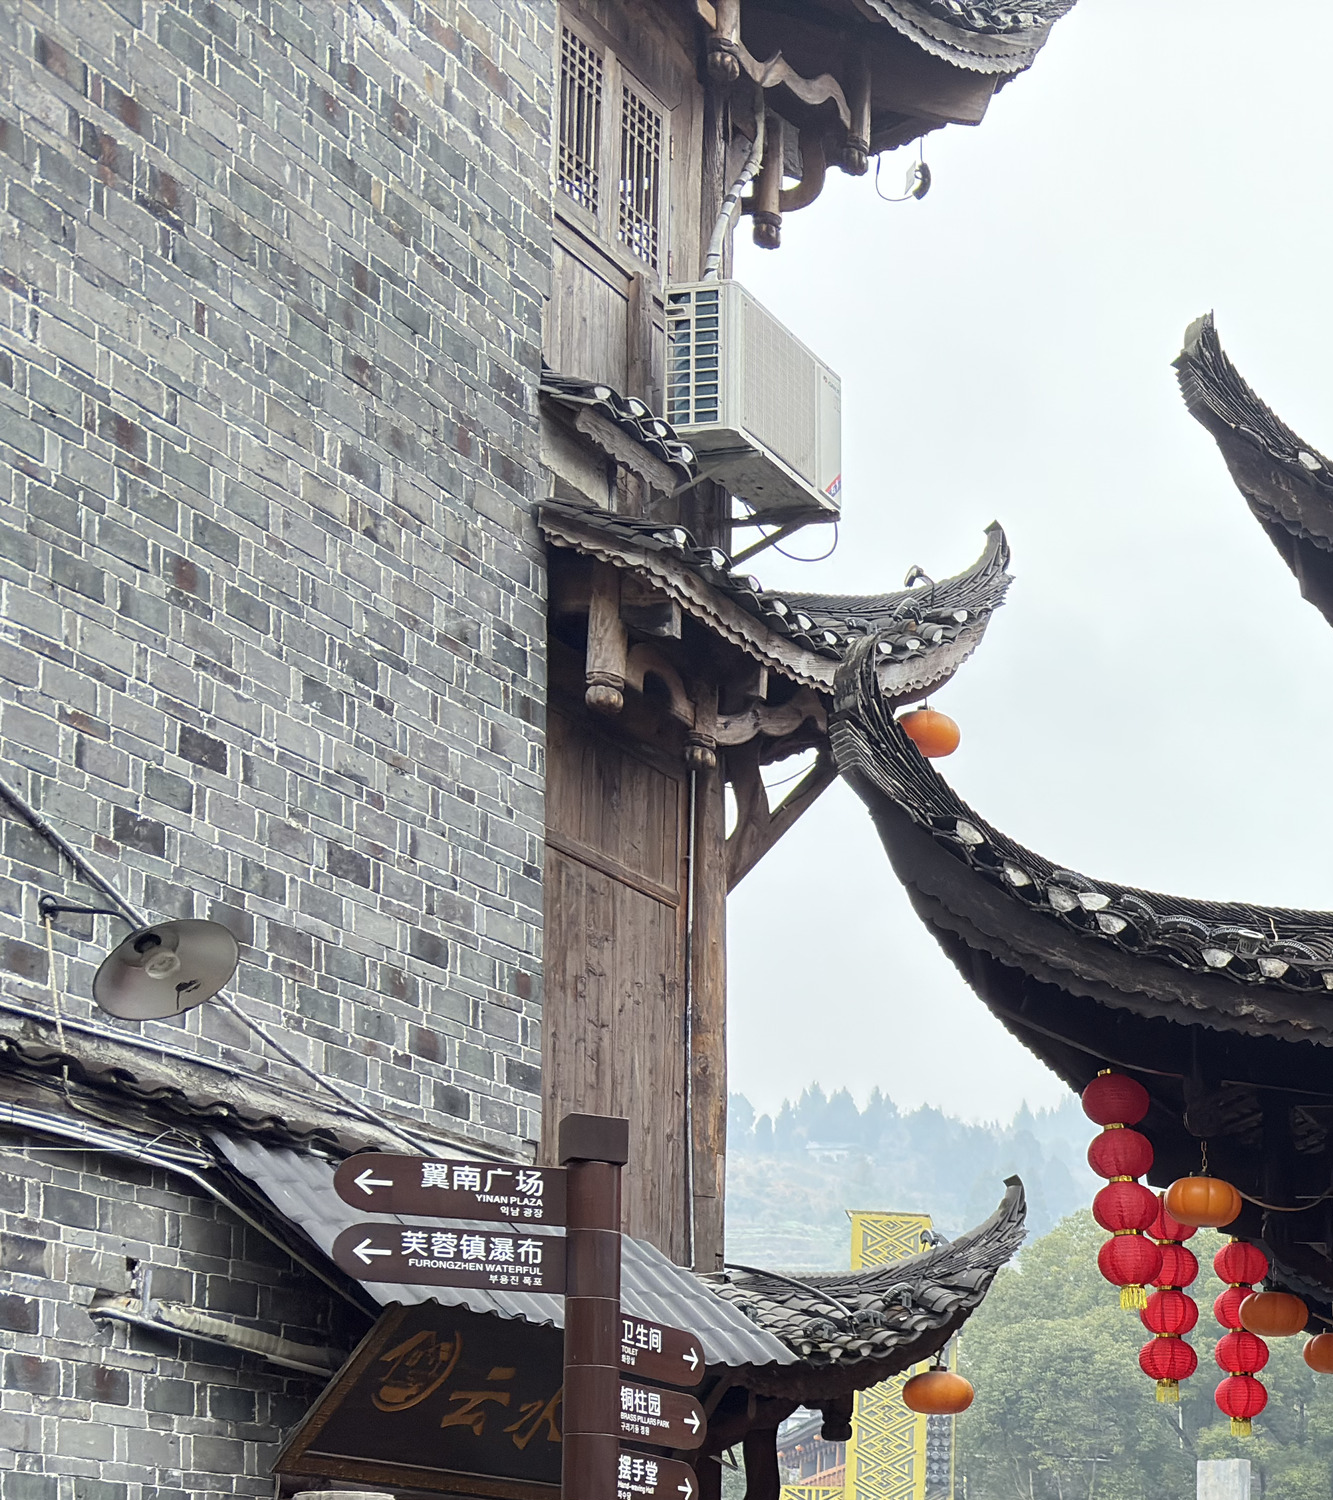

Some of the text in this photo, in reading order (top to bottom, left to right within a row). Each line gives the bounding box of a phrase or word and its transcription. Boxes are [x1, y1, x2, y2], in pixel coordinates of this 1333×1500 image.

[420, 1162, 545, 1197] 翼南广场
[475, 1194, 543, 1207] YINAN PLAZA
[523, 1207, 543, 1218] 광장
[401, 1230, 544, 1264] 芙蓉镇瀑布
[408, 1258, 543, 1275] FURONGZHEN WATERFUL
[488, 1274, 543, 1286] 부용진 폭포
[621, 1319, 662, 1353] 卫生间
[621, 1345, 639, 1356] TOILET
[620, 1386, 661, 1416] 铜柱园
[620, 1412, 670, 1429] BRASS PILLARS PARK
[618, 1454, 658, 1486] 摆手堂
